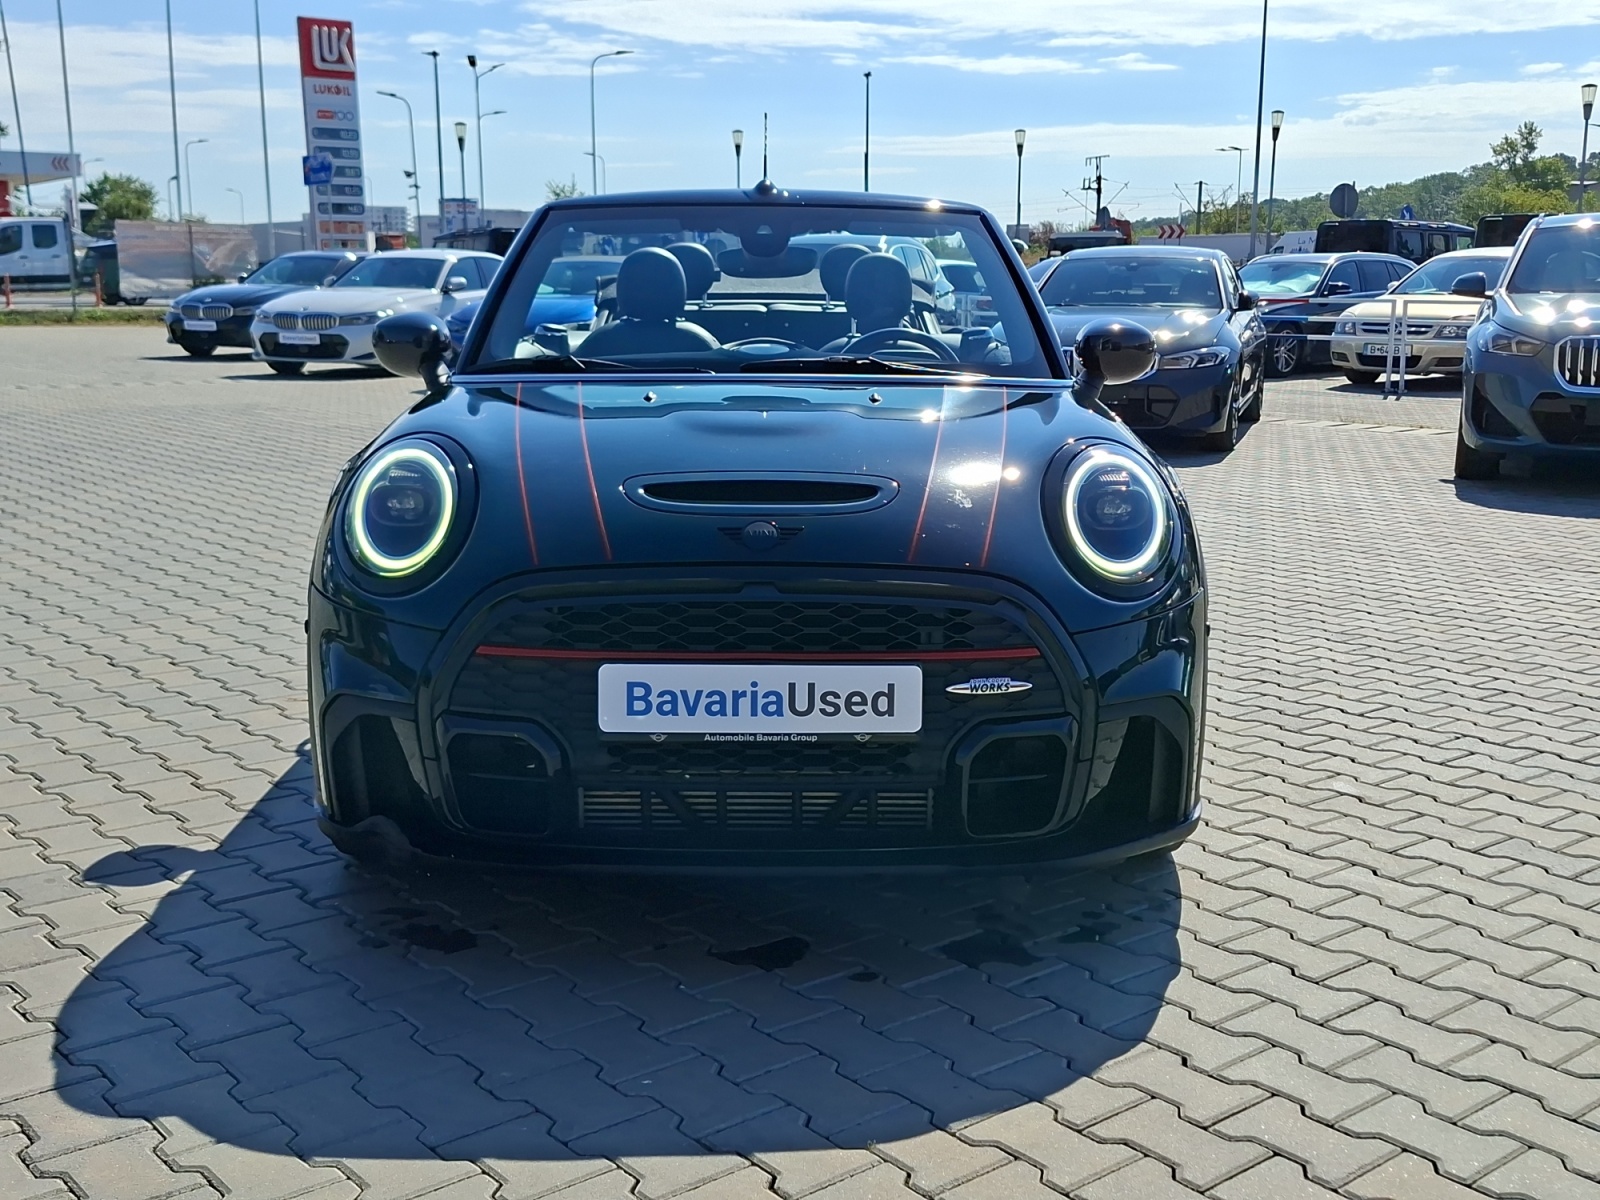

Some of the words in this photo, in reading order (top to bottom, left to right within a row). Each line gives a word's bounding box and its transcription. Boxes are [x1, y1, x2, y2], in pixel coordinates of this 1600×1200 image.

[313, 83, 352, 97] LUKOIL
[969, 683, 1011, 693] WORKS
[625, 681, 896, 718] BavariaUsed
[704, 733, 755, 742] Automobile
[756, 733, 789, 742] Bavaria
[790, 733, 818, 743] Group
